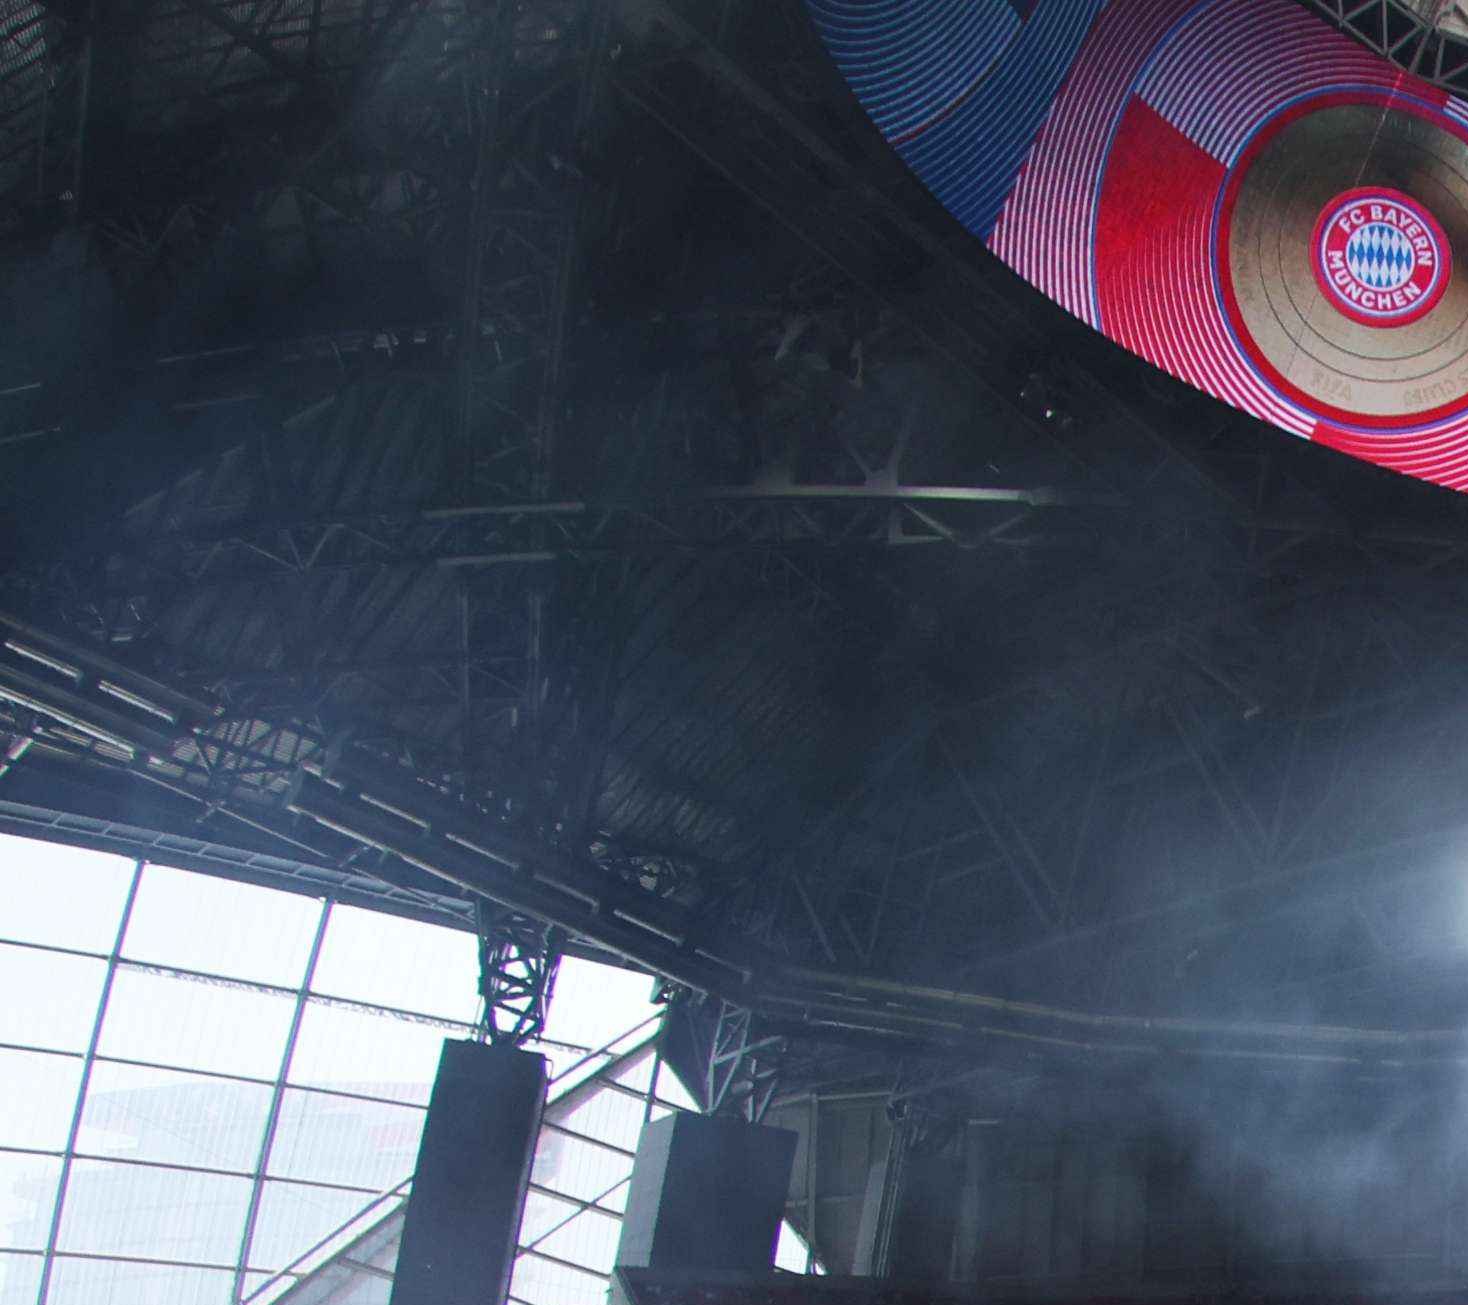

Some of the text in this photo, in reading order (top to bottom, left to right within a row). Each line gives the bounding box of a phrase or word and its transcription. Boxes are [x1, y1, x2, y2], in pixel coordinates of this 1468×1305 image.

[1337, 203, 1433, 267] FC BAYERN
[1326, 250, 1421, 310] MÜNCHEN
